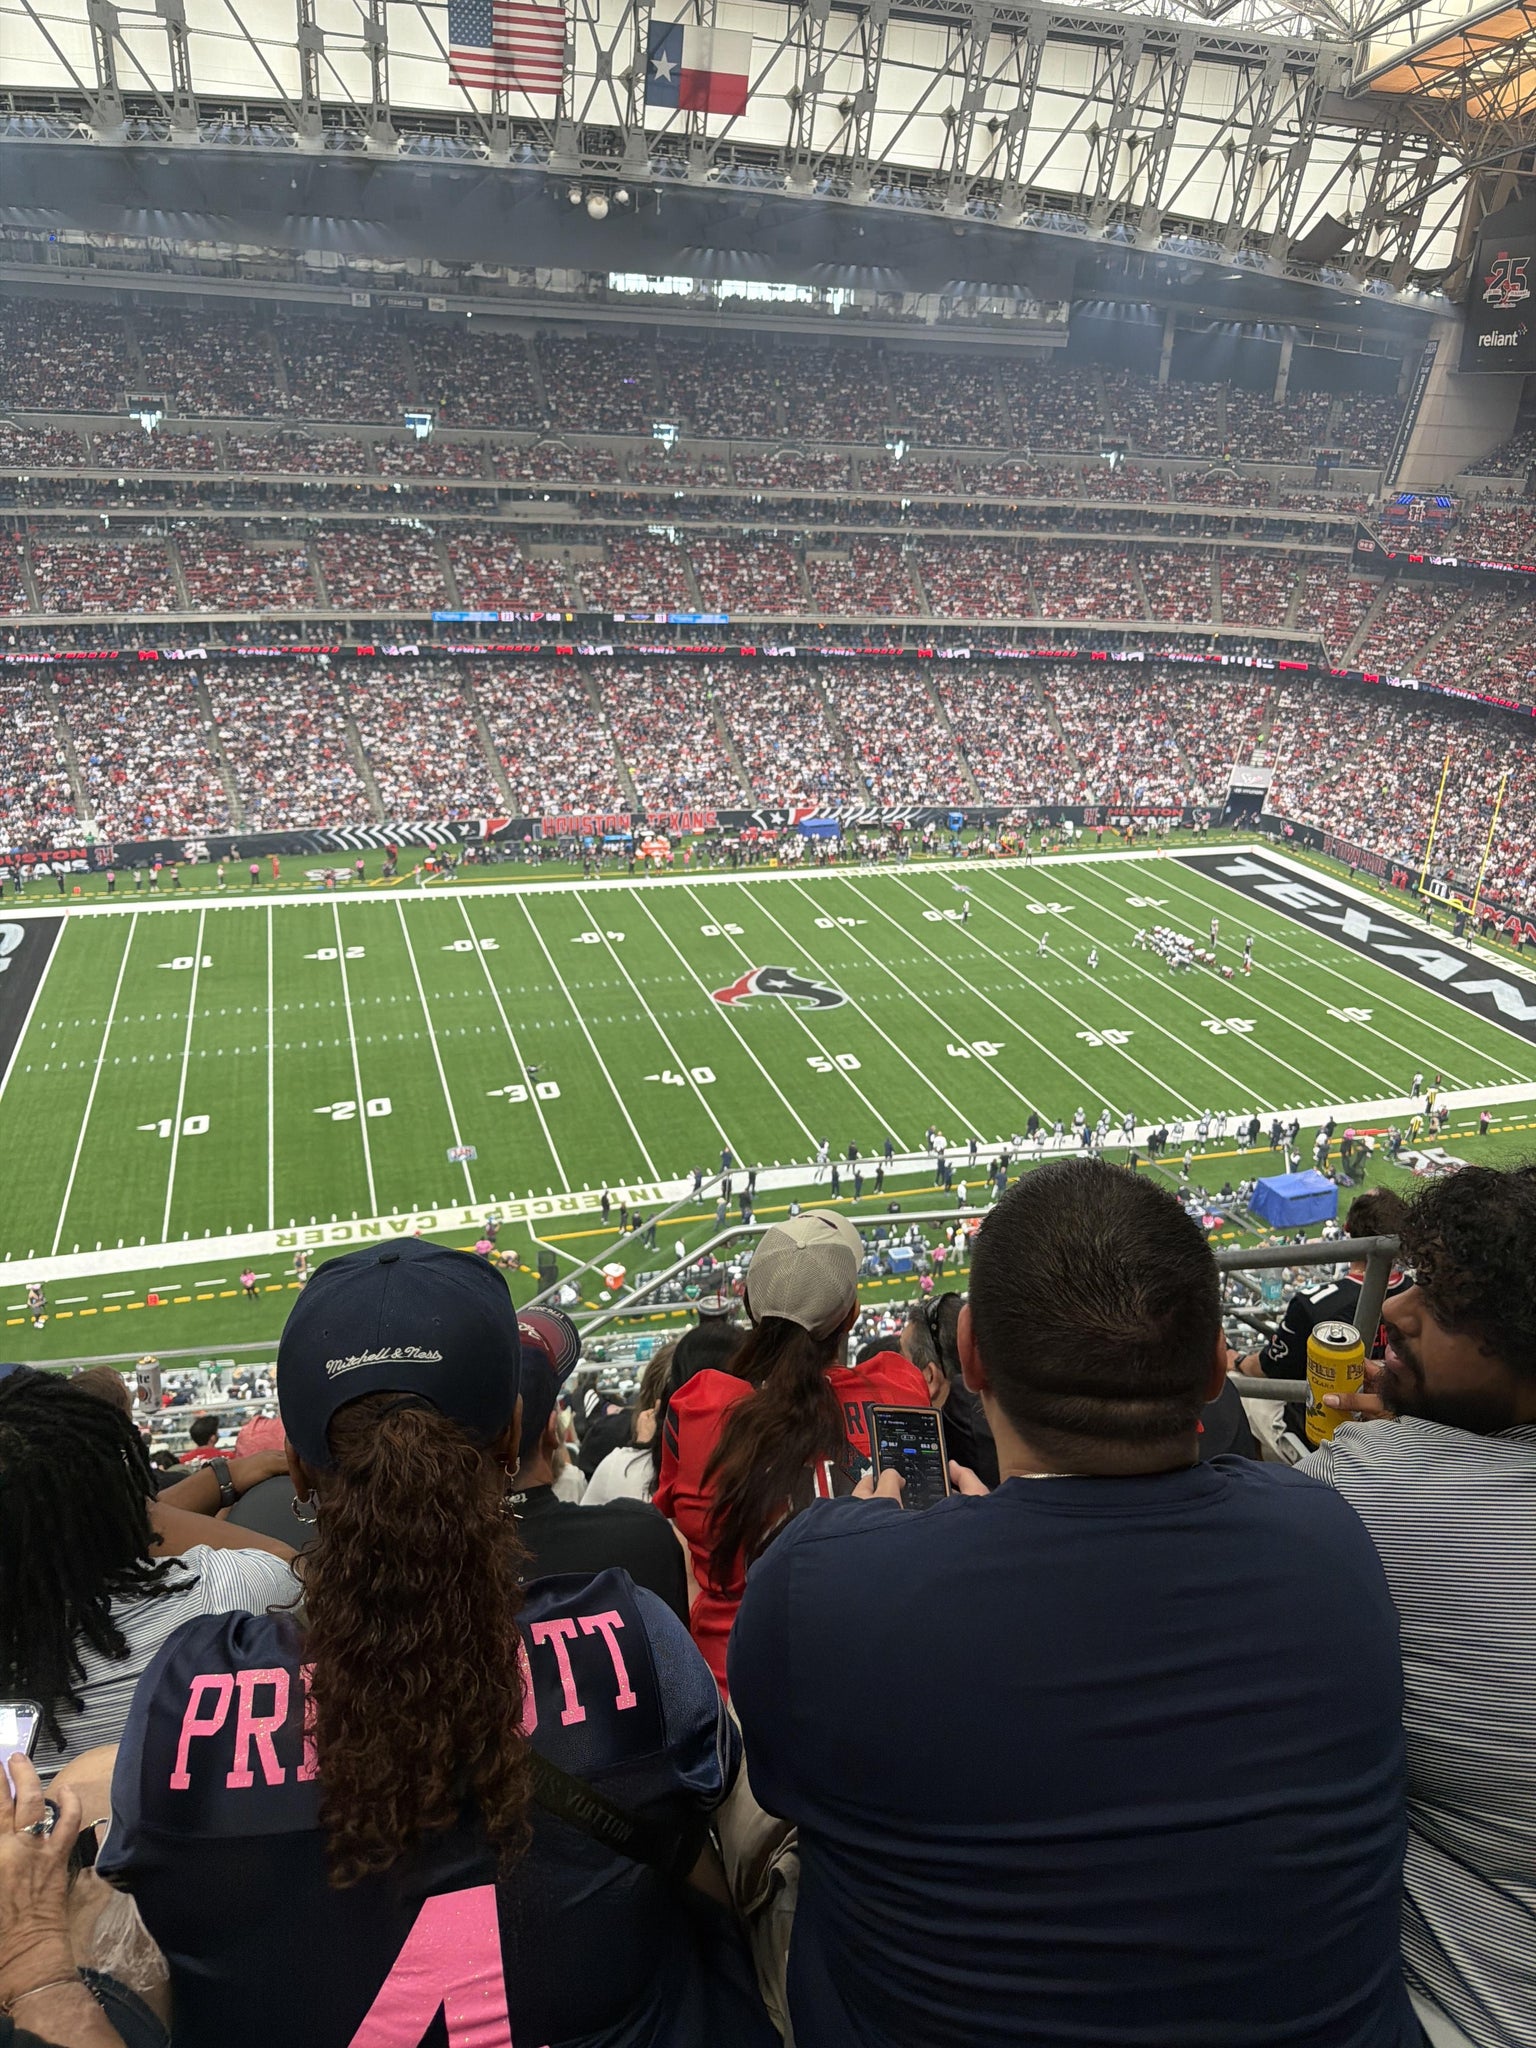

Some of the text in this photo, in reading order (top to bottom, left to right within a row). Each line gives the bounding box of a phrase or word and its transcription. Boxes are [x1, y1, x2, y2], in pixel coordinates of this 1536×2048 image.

[1490, 257, 1531, 303] 25
[1478, 331, 1518, 347] reliant
[541, 814, 631, 837] HOUSTON
[0, 848, 87, 866] USTON
[581, 931, 626, 944] 40
[700, 923, 745, 937] 50
[317, 946, 366, 961] 20
[453, 938, 500, 952] 30
[171, 955, 214, 970] 10
[1326, 1007, 1372, 1023] 10
[1200, 1017, 1253, 1035] 20
[1075, 1028, 1128, 1047] 30
[946, 1040, 999, 1058] 40
[806, 1053, 861, 1073] 50
[661, 1066, 717, 1087] 40
[503, 1081, 561, 1104] 30
[331, 1097, 392, 1121] 20
[157, 1115, 210, 1138] 10
[276, 1186, 663, 1248] INTERCEPT CANCER
[326, 1345, 443, 1379] Mitchell & Ness
